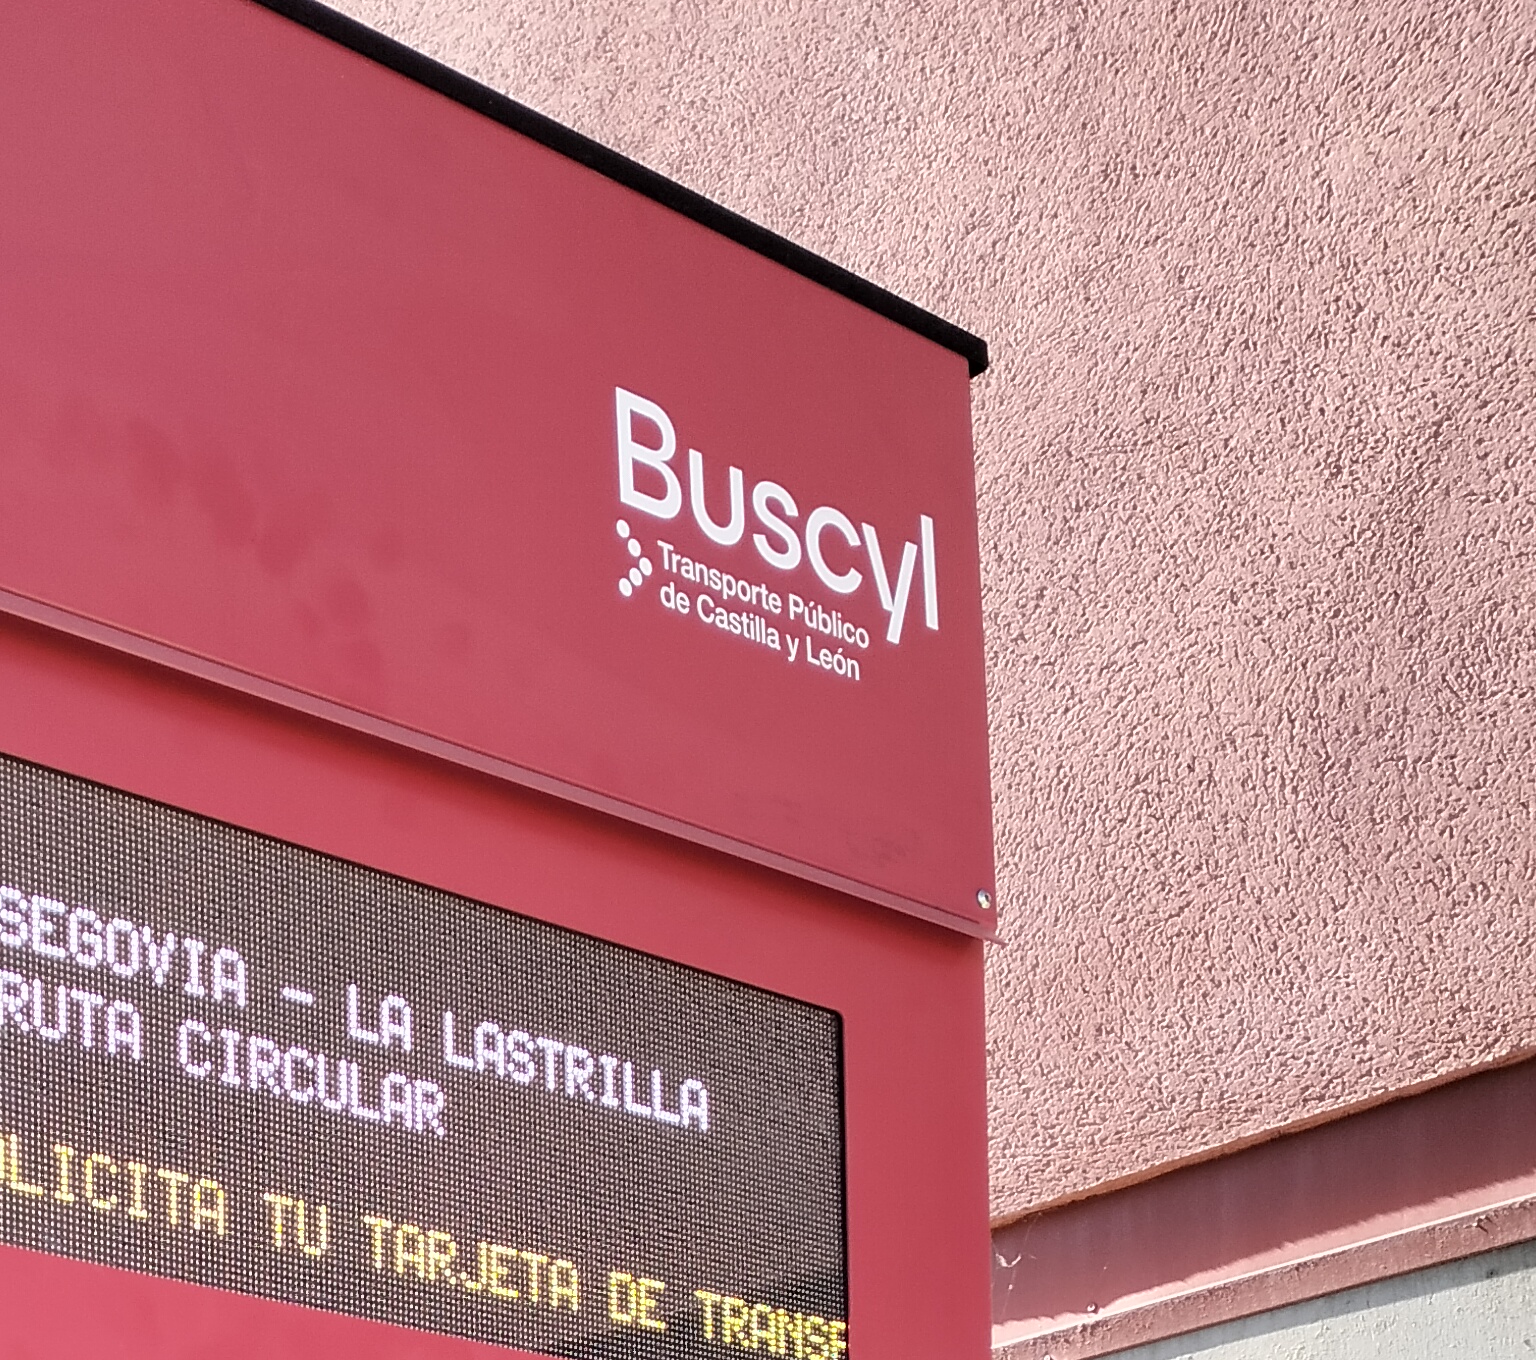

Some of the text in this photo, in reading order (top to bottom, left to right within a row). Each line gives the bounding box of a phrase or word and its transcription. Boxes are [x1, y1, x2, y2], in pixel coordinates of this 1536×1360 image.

[616, 386, 939, 644] Buscyl
[657, 540, 870, 649] Transporte Público
[660, 582, 861, 681] de Castilla y León
[178, 1019, 444, 1136] CIRCULAR
[346, 984, 412, 1051] LA
[444, 1011, 709, 1133] LASTRILLA
[263, 1191, 328, 1255] TU
[364, 1215, 579, 1311] TARJETA
[608, 1270, 666, 1331] DE
